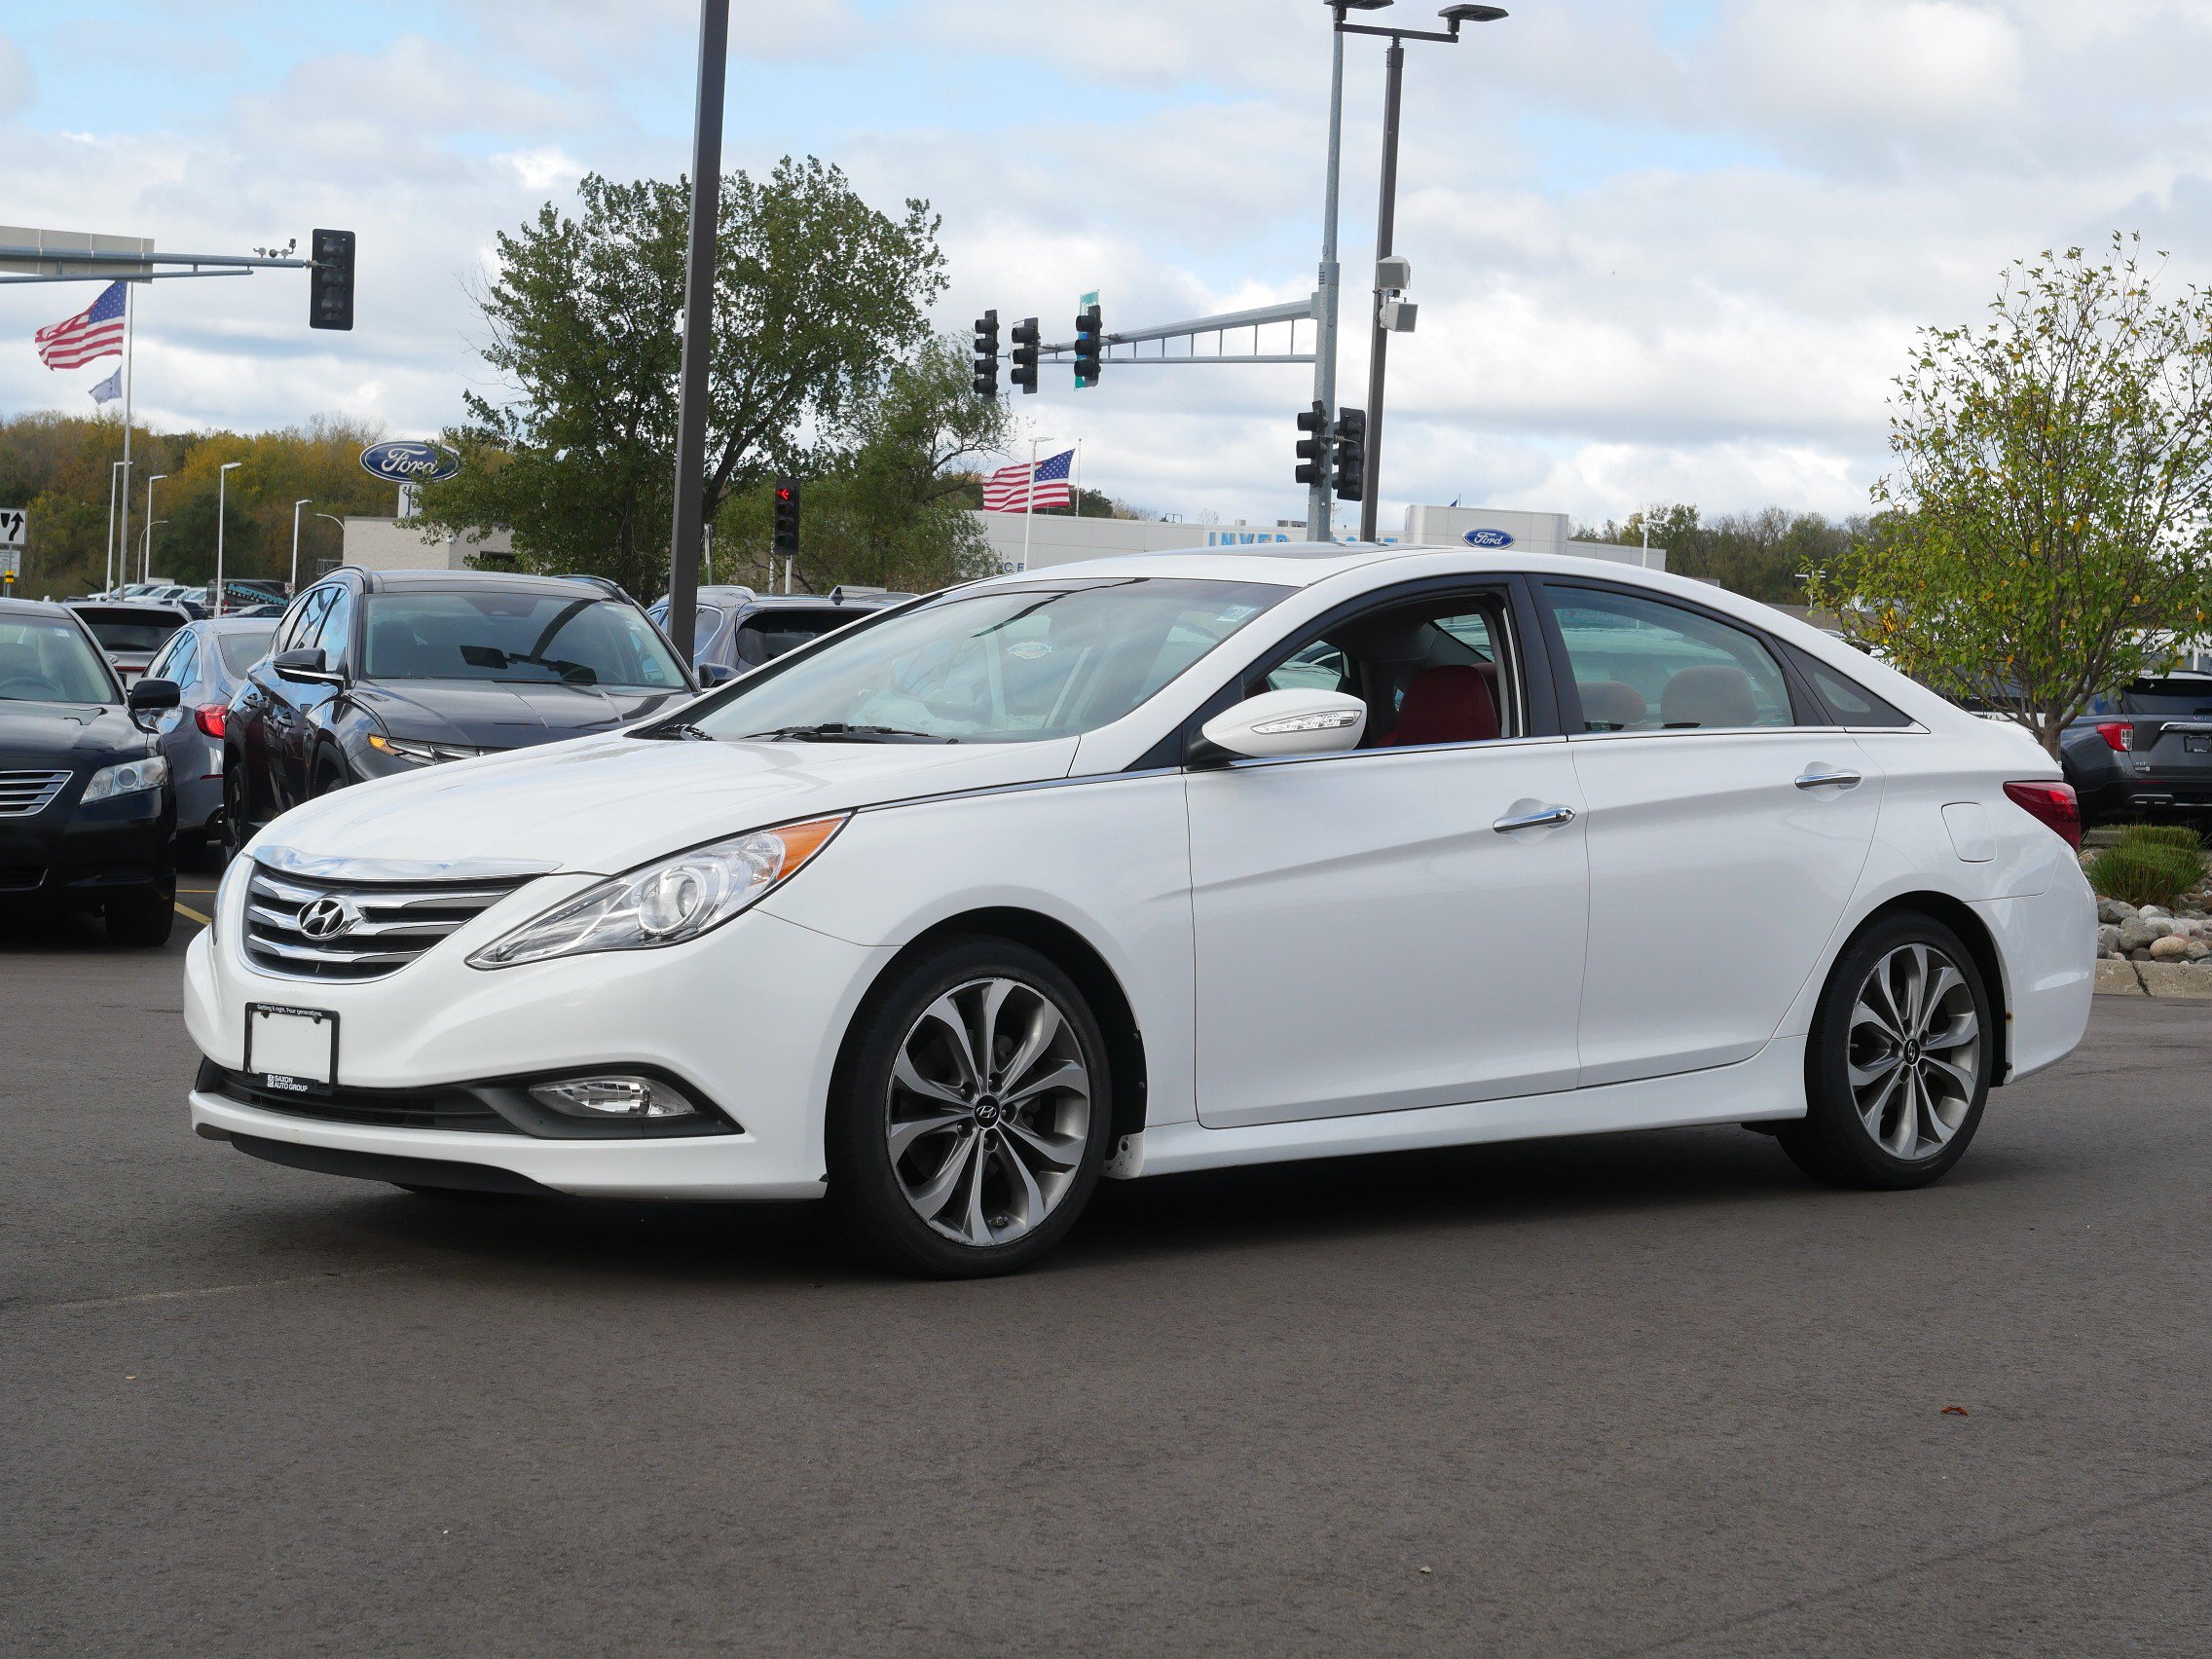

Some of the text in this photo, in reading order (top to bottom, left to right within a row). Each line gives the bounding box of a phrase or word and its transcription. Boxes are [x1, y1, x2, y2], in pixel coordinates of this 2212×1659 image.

[381, 448, 439, 475] Ford
[1474, 532, 1503, 544] Ford
[228, 590, 260, 602] HEATING
[229, 583, 289, 606] MIDTOWN
[274, 1075, 294, 1083] SAXON
[274, 1081, 308, 1092] AUTO GROUP
